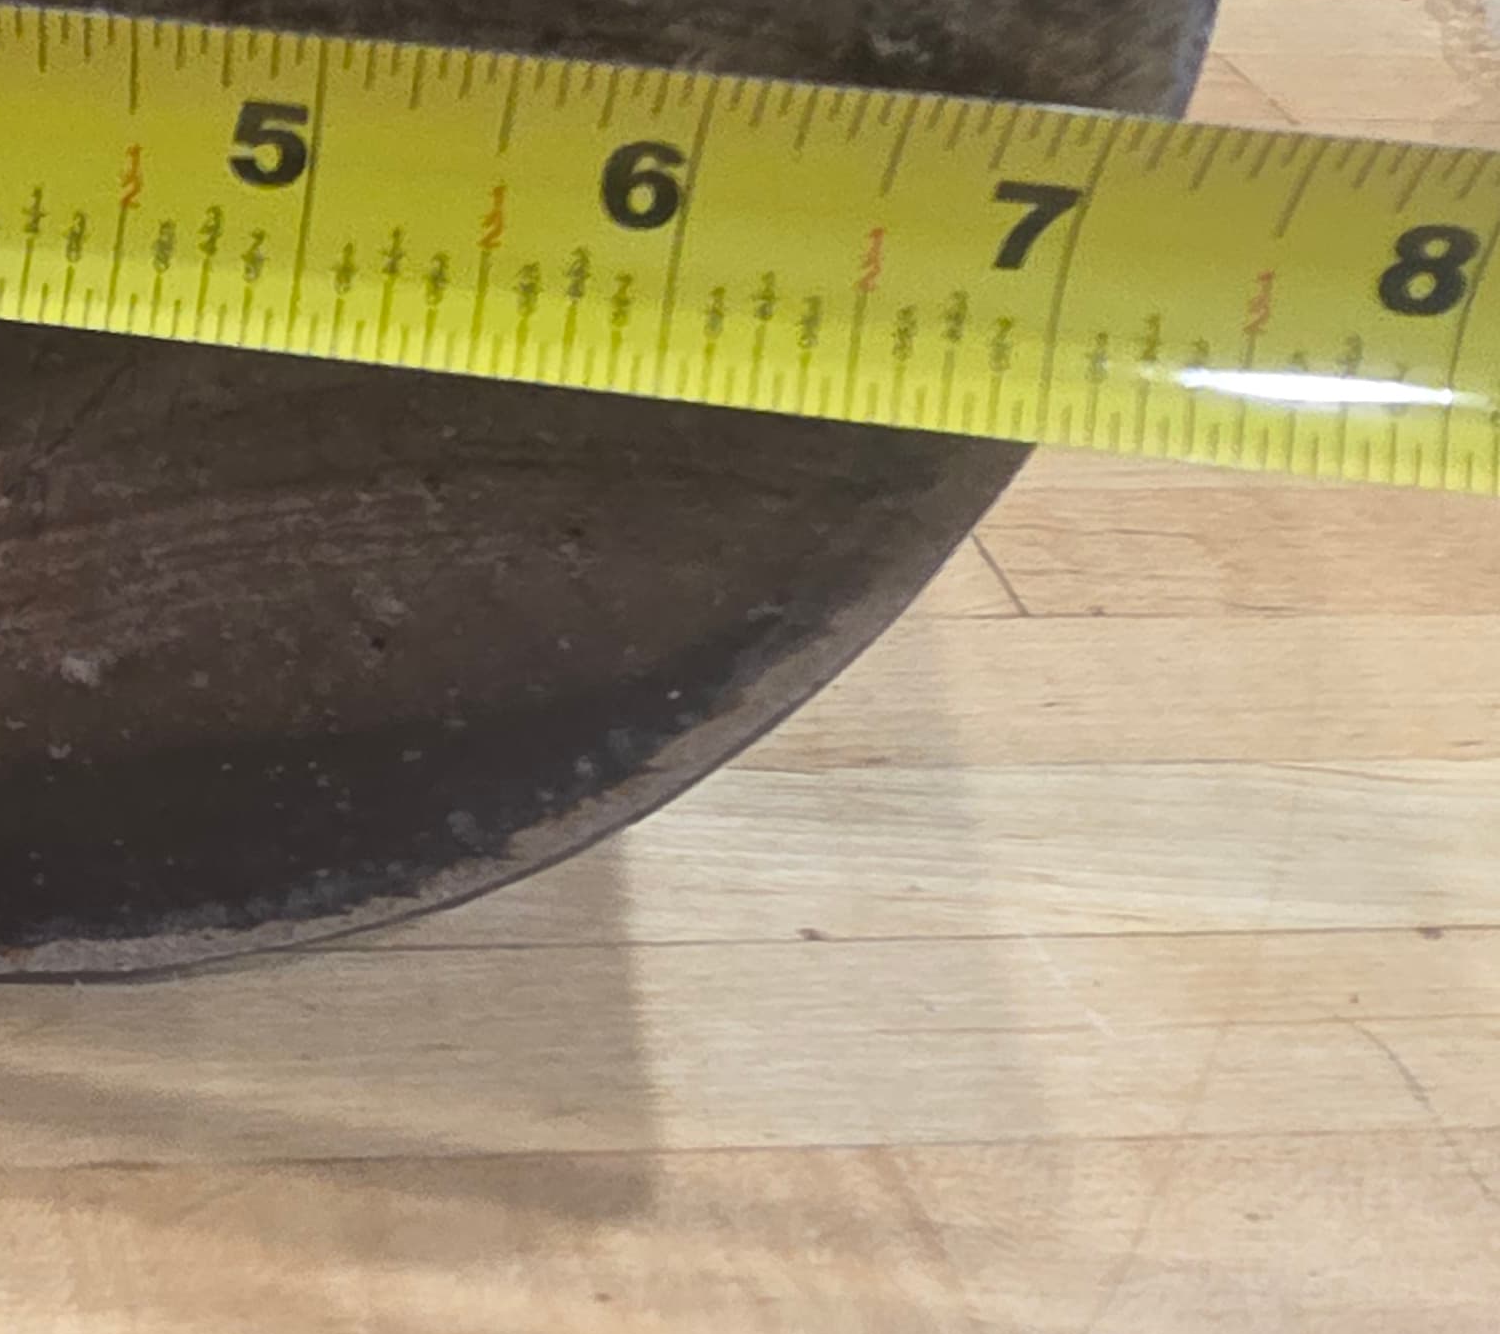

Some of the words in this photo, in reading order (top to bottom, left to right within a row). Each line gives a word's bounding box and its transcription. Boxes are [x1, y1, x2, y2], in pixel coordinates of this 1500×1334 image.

[228, 100, 310, 189] 5
[602, 140, 687, 231] 6
[993, 180, 1084, 271] 7
[1377, 224, 1481, 317] 8
